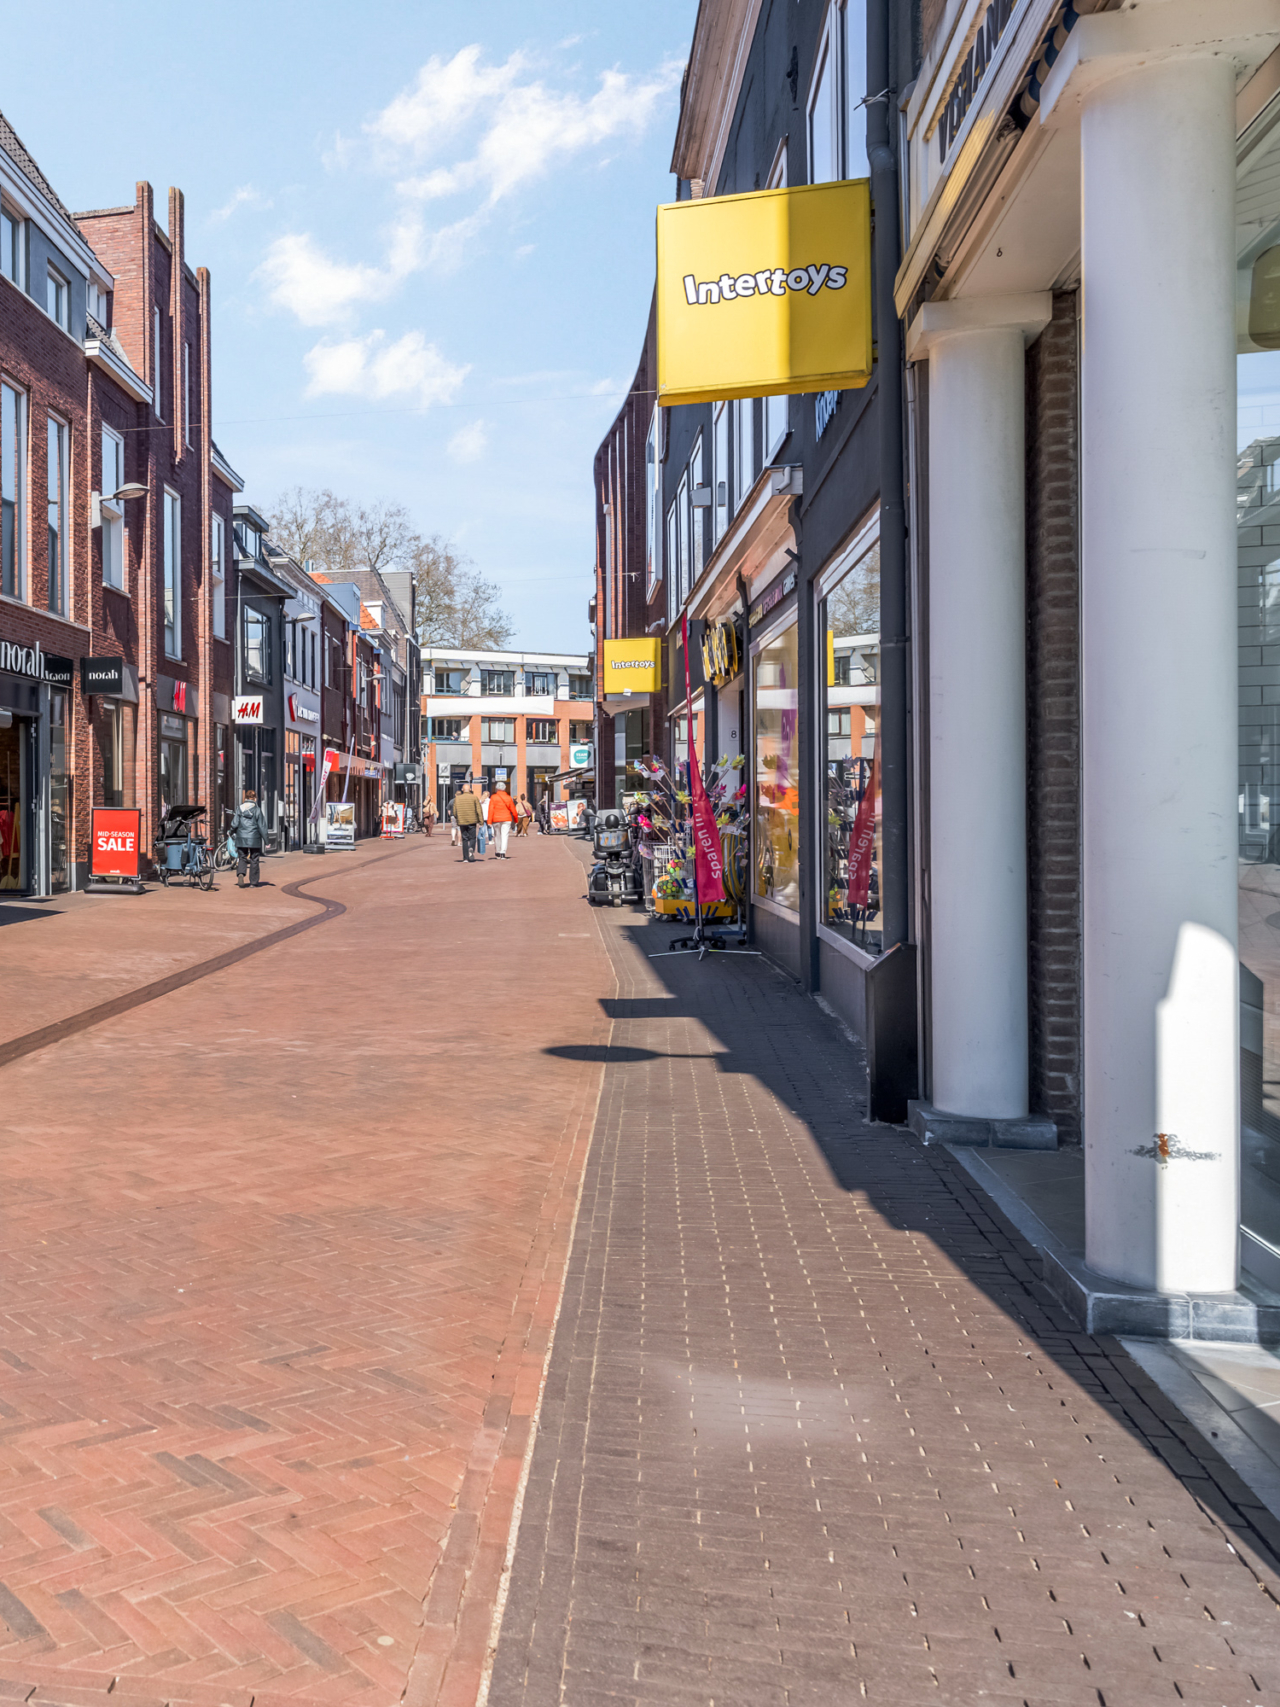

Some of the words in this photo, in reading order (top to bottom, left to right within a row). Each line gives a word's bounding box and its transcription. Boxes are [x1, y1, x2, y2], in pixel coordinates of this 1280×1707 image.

[682, 263, 849, 305] Intertoys
[0, 641, 45, 679] norah
[611, 660, 656, 669] Intertoys
[88, 669, 119, 680] norah
[237, 701, 261, 718] H&M
[731, 730, 737, 739] 8
[97, 838, 135, 851] SALE
